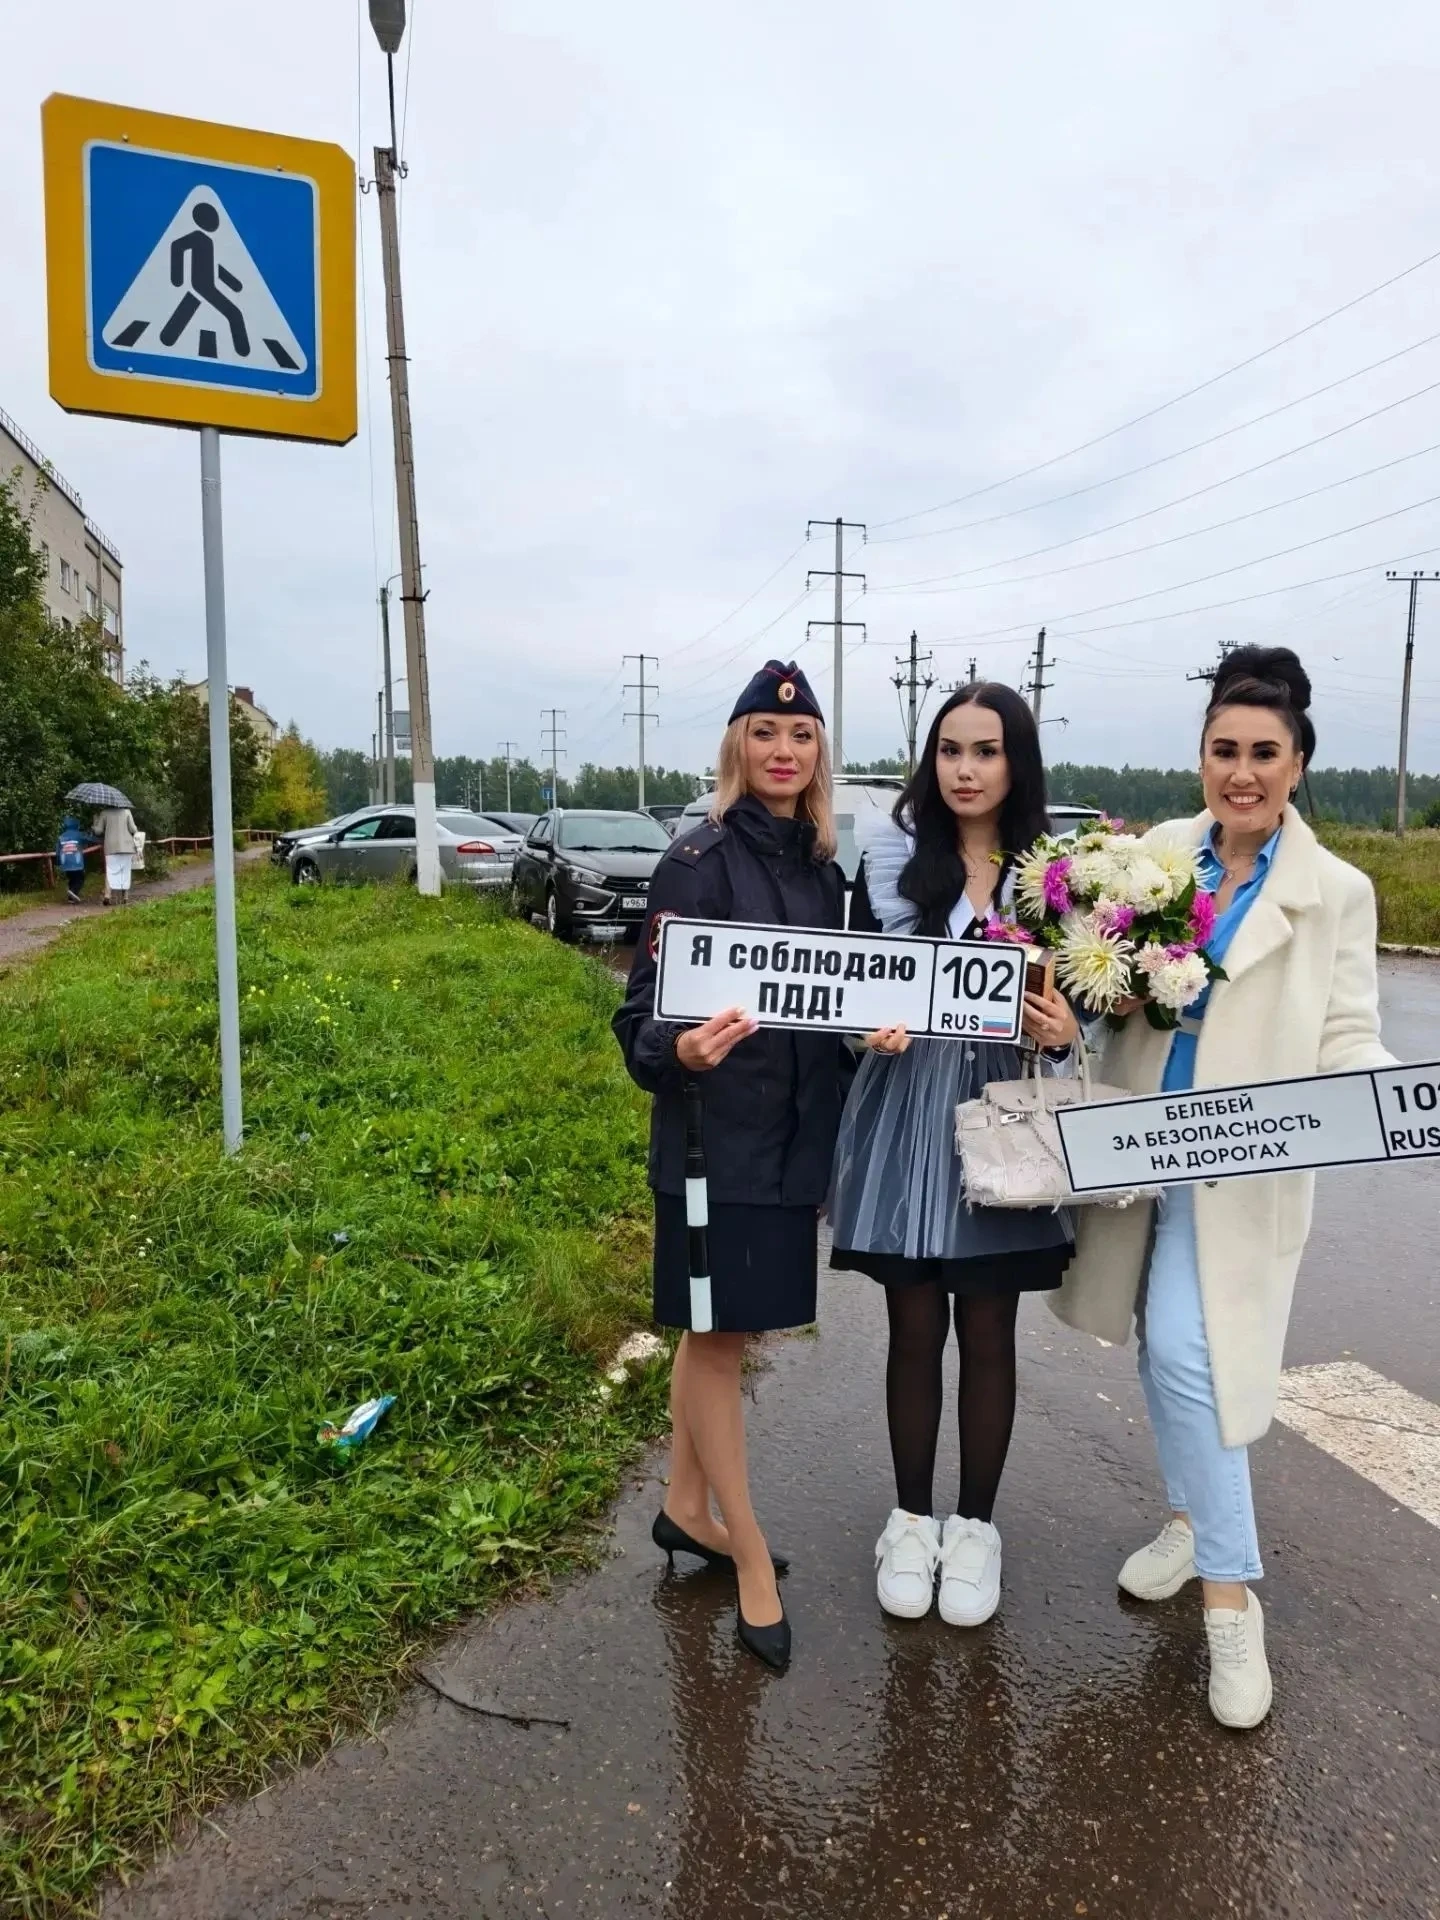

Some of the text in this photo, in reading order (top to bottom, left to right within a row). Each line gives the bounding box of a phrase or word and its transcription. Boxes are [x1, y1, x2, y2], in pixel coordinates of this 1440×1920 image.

[691, 935, 917, 982] Я соблюдаю
[942, 956, 1015, 1003] 102
[758, 981, 844, 1021] ПДД!
[941, 1012, 980, 1032] RUS
[1165, 1093, 1254, 1121] БЕЛЕБЕЙ
[1392, 1082, 1440, 1113] 10
[1112, 1113, 1321, 1151] ЗА БЕЗОПАСНОСТЬ
[1389, 1126, 1440, 1151] RUS
[1150, 1141, 1289, 1170] НА ДОРОГАХ
